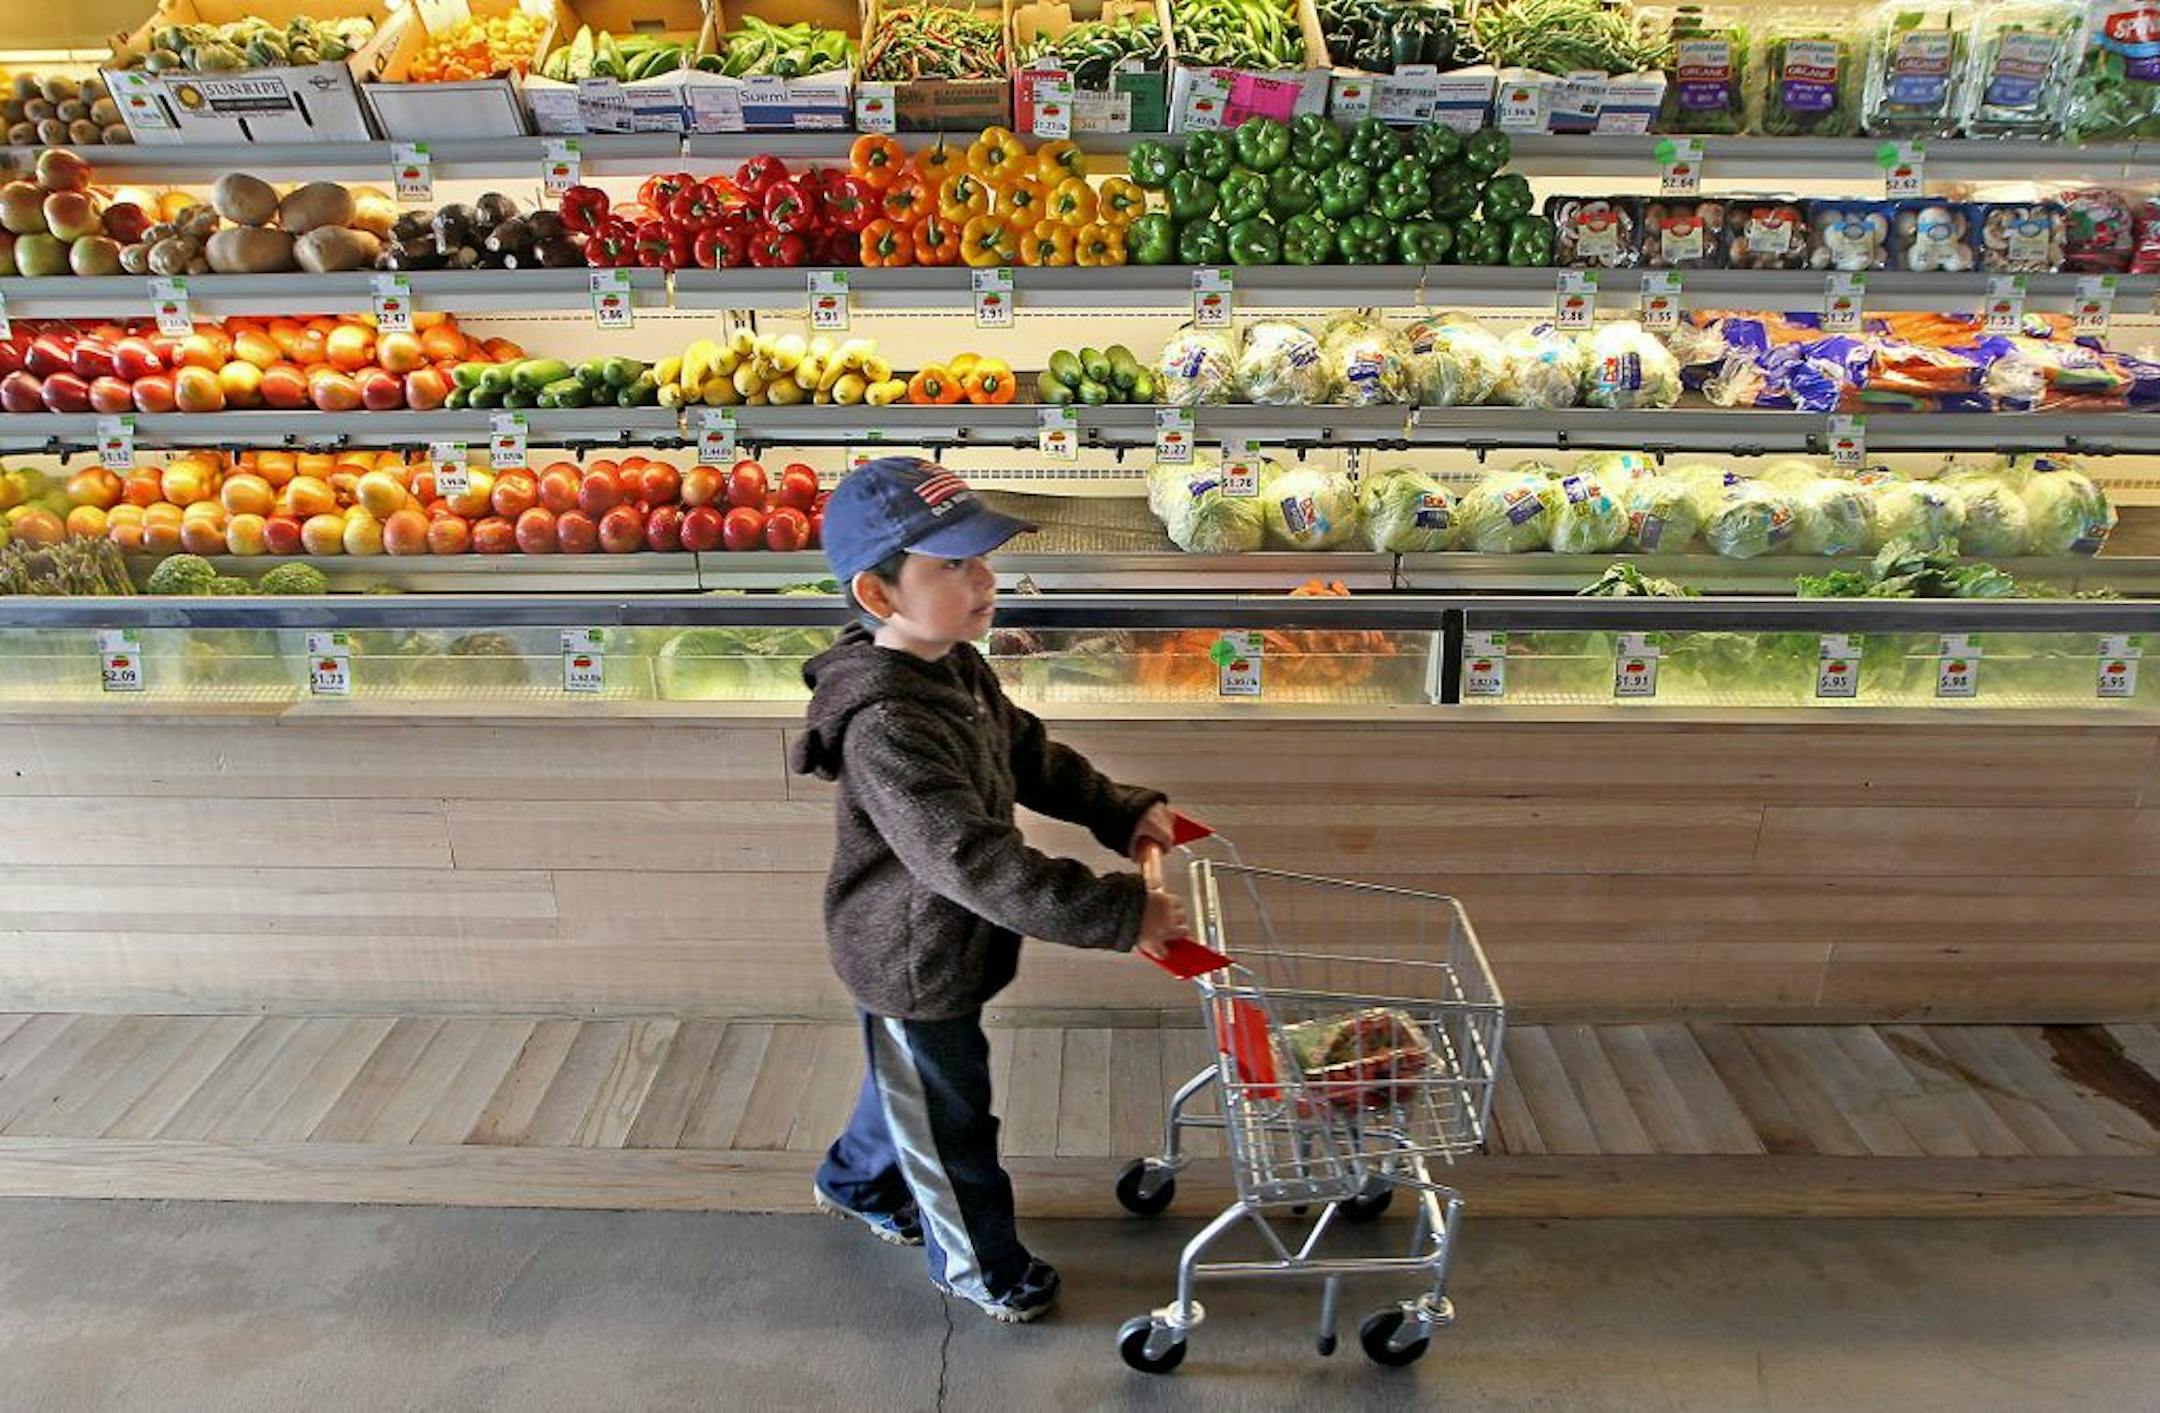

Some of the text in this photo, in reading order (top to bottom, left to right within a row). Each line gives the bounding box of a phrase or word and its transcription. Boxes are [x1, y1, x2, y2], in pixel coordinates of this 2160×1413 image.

[1680, 66, 1726, 77] ORGANIC
[1786, 66, 1833, 78] ORGANIC
[206, 82, 284, 97] SUNRIPE
[102, 670, 135, 682] $2.09
